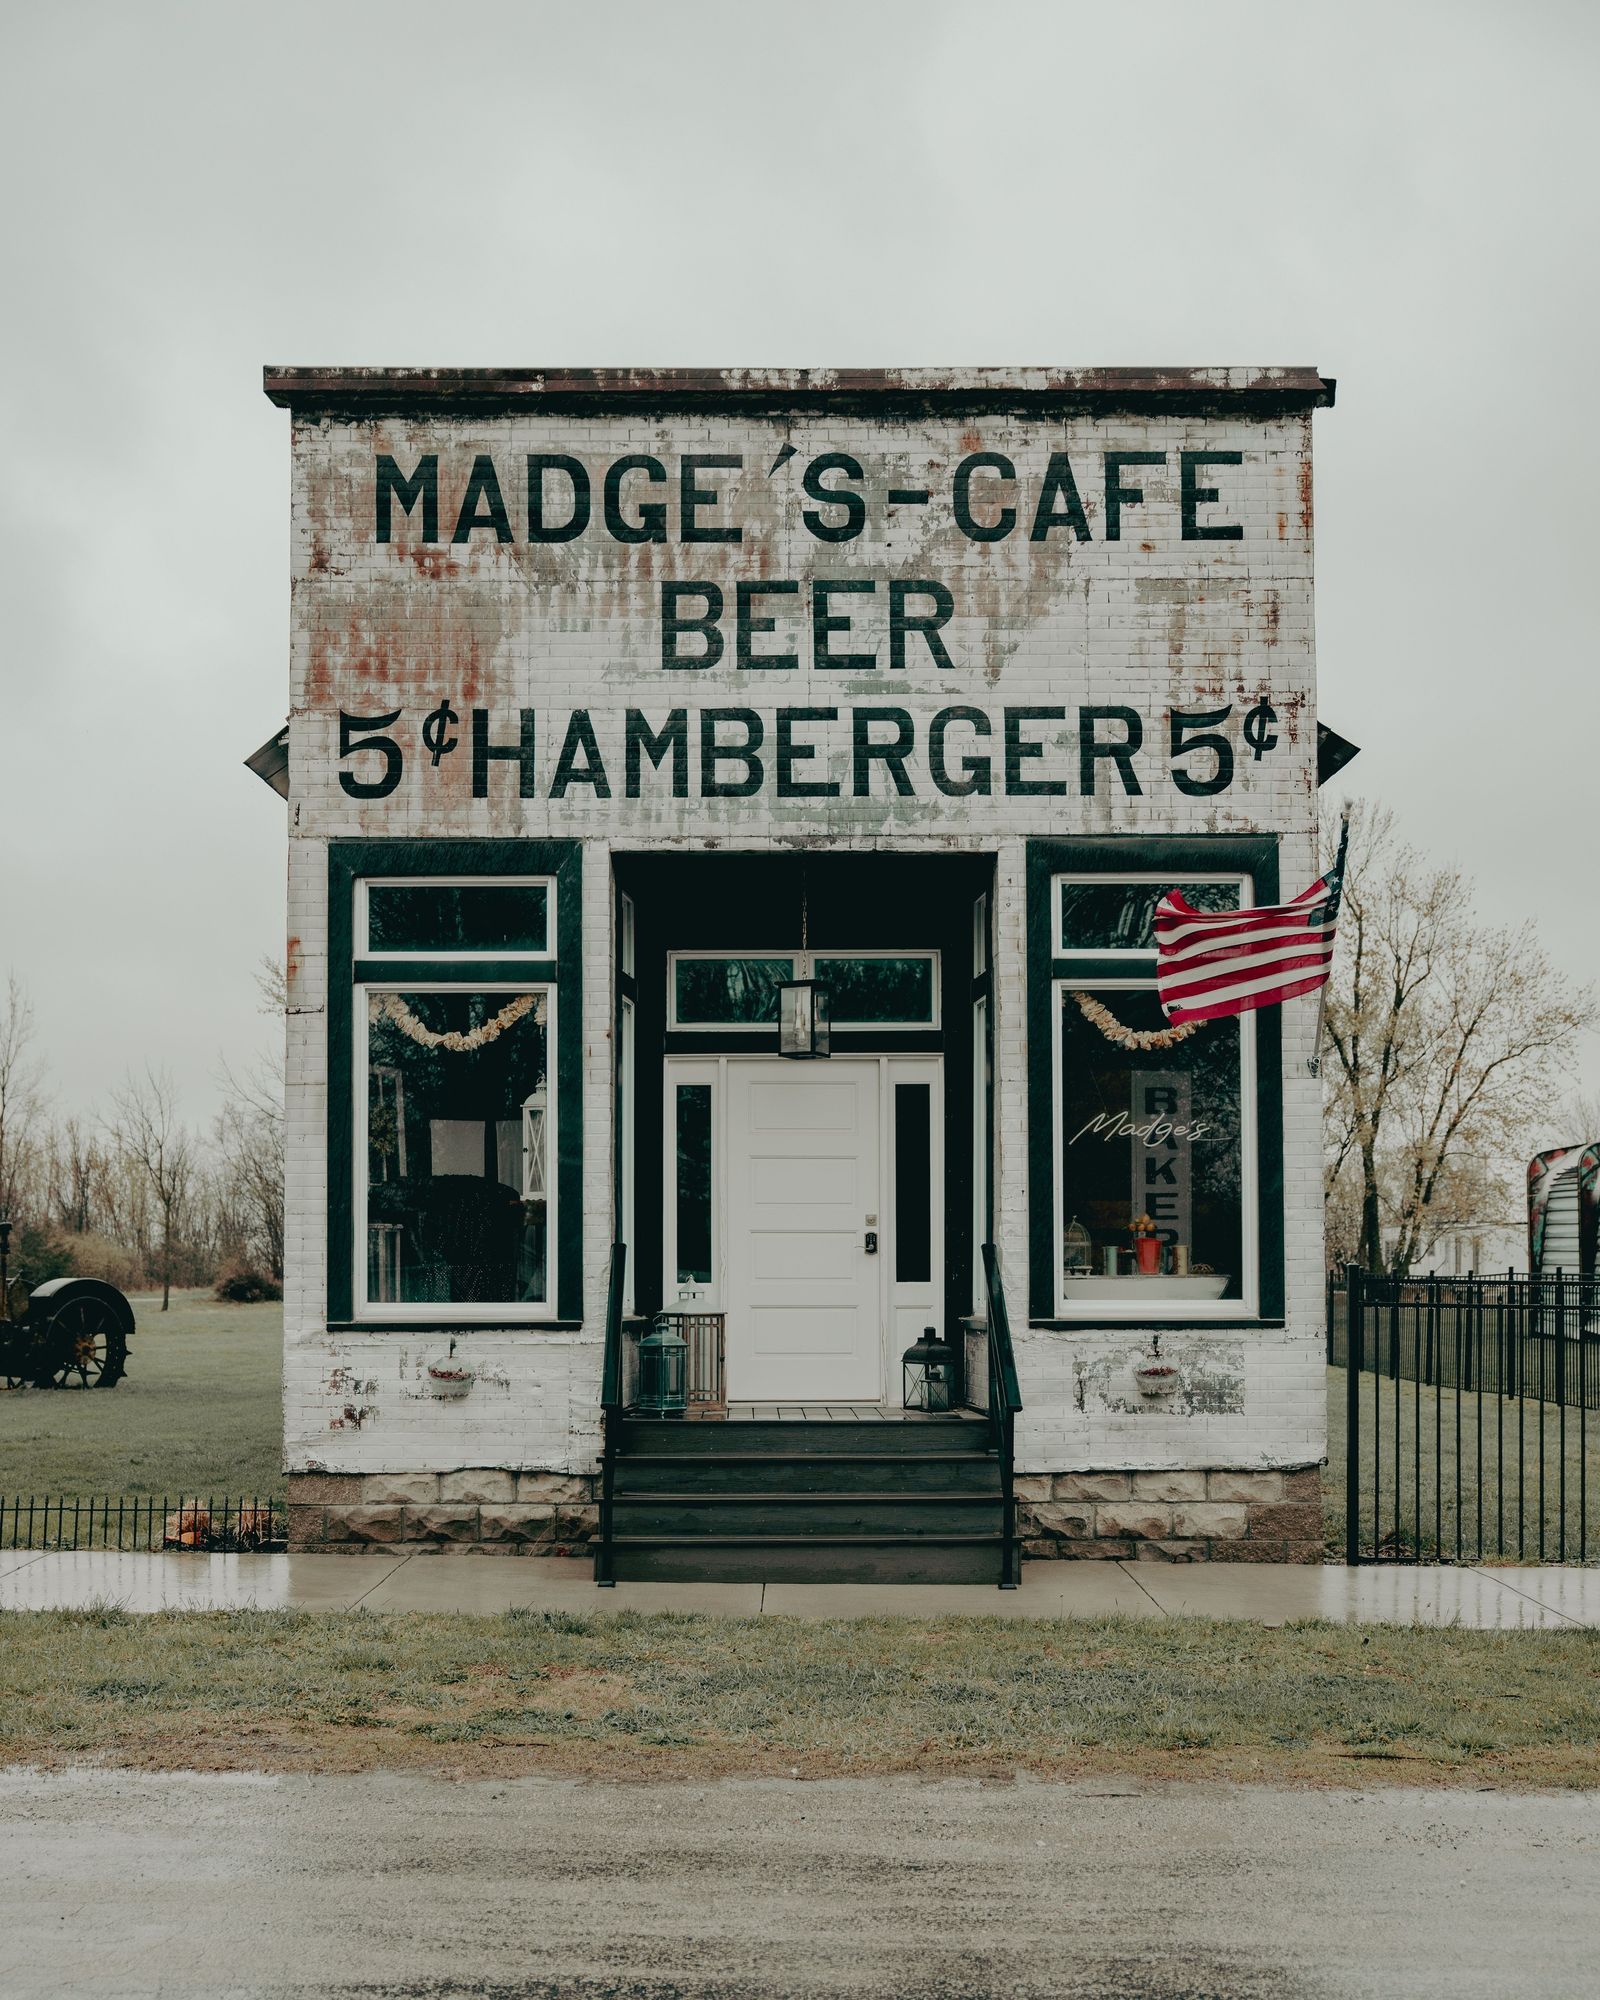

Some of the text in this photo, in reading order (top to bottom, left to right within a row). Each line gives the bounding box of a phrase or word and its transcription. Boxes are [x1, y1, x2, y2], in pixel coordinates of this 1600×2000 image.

[661, 579, 956, 671] BEER
[471, 705, 1144, 799] HAMBERGER
[1068, 1110, 1233, 1148] Madge's
